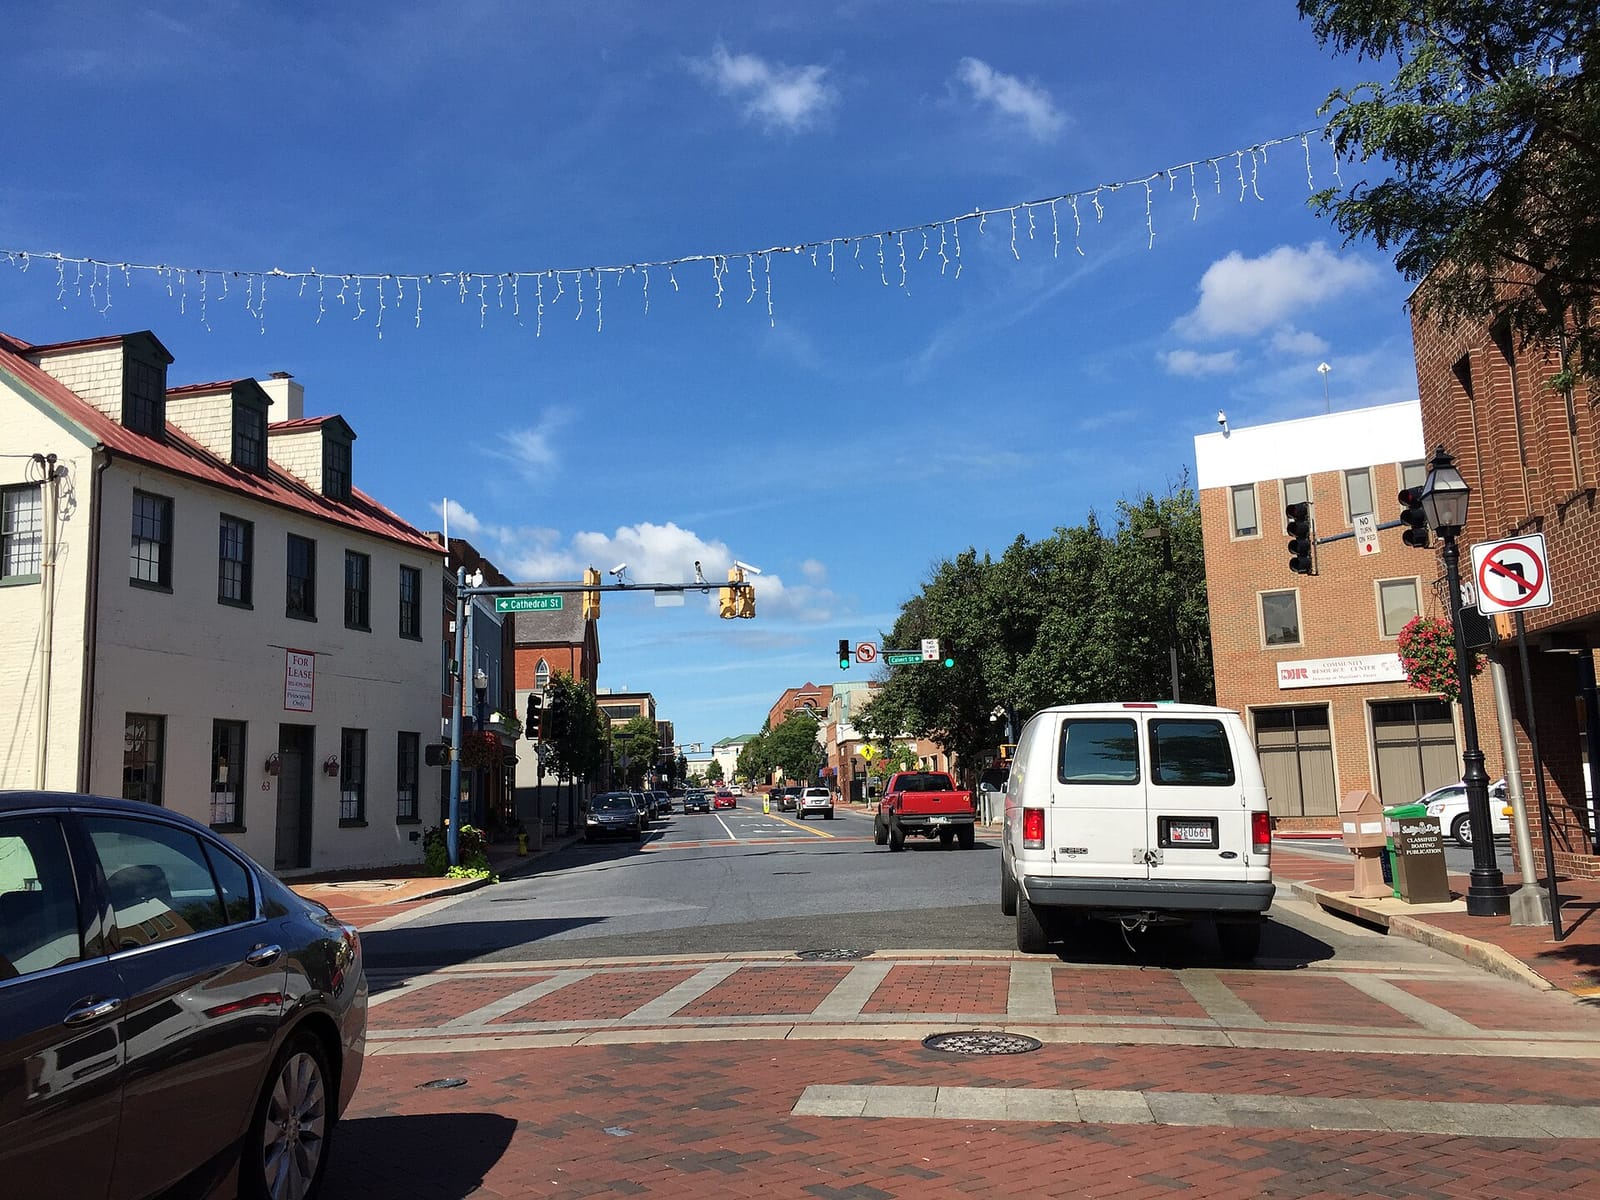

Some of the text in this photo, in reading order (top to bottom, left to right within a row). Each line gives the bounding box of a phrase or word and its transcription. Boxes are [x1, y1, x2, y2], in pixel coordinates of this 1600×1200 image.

[1359, 517, 1369, 525] NO
[1360, 526, 1373, 534] TURN
[510, 598, 559, 609] Cathedral St
[293, 655, 309, 667] FOR
[1322, 660, 1364, 668] COMMUNITY
[288, 667, 313, 680] LEASE
[261, 781, 271, 791] 63
[1406, 848, 1442, 856] PUBLICATION
